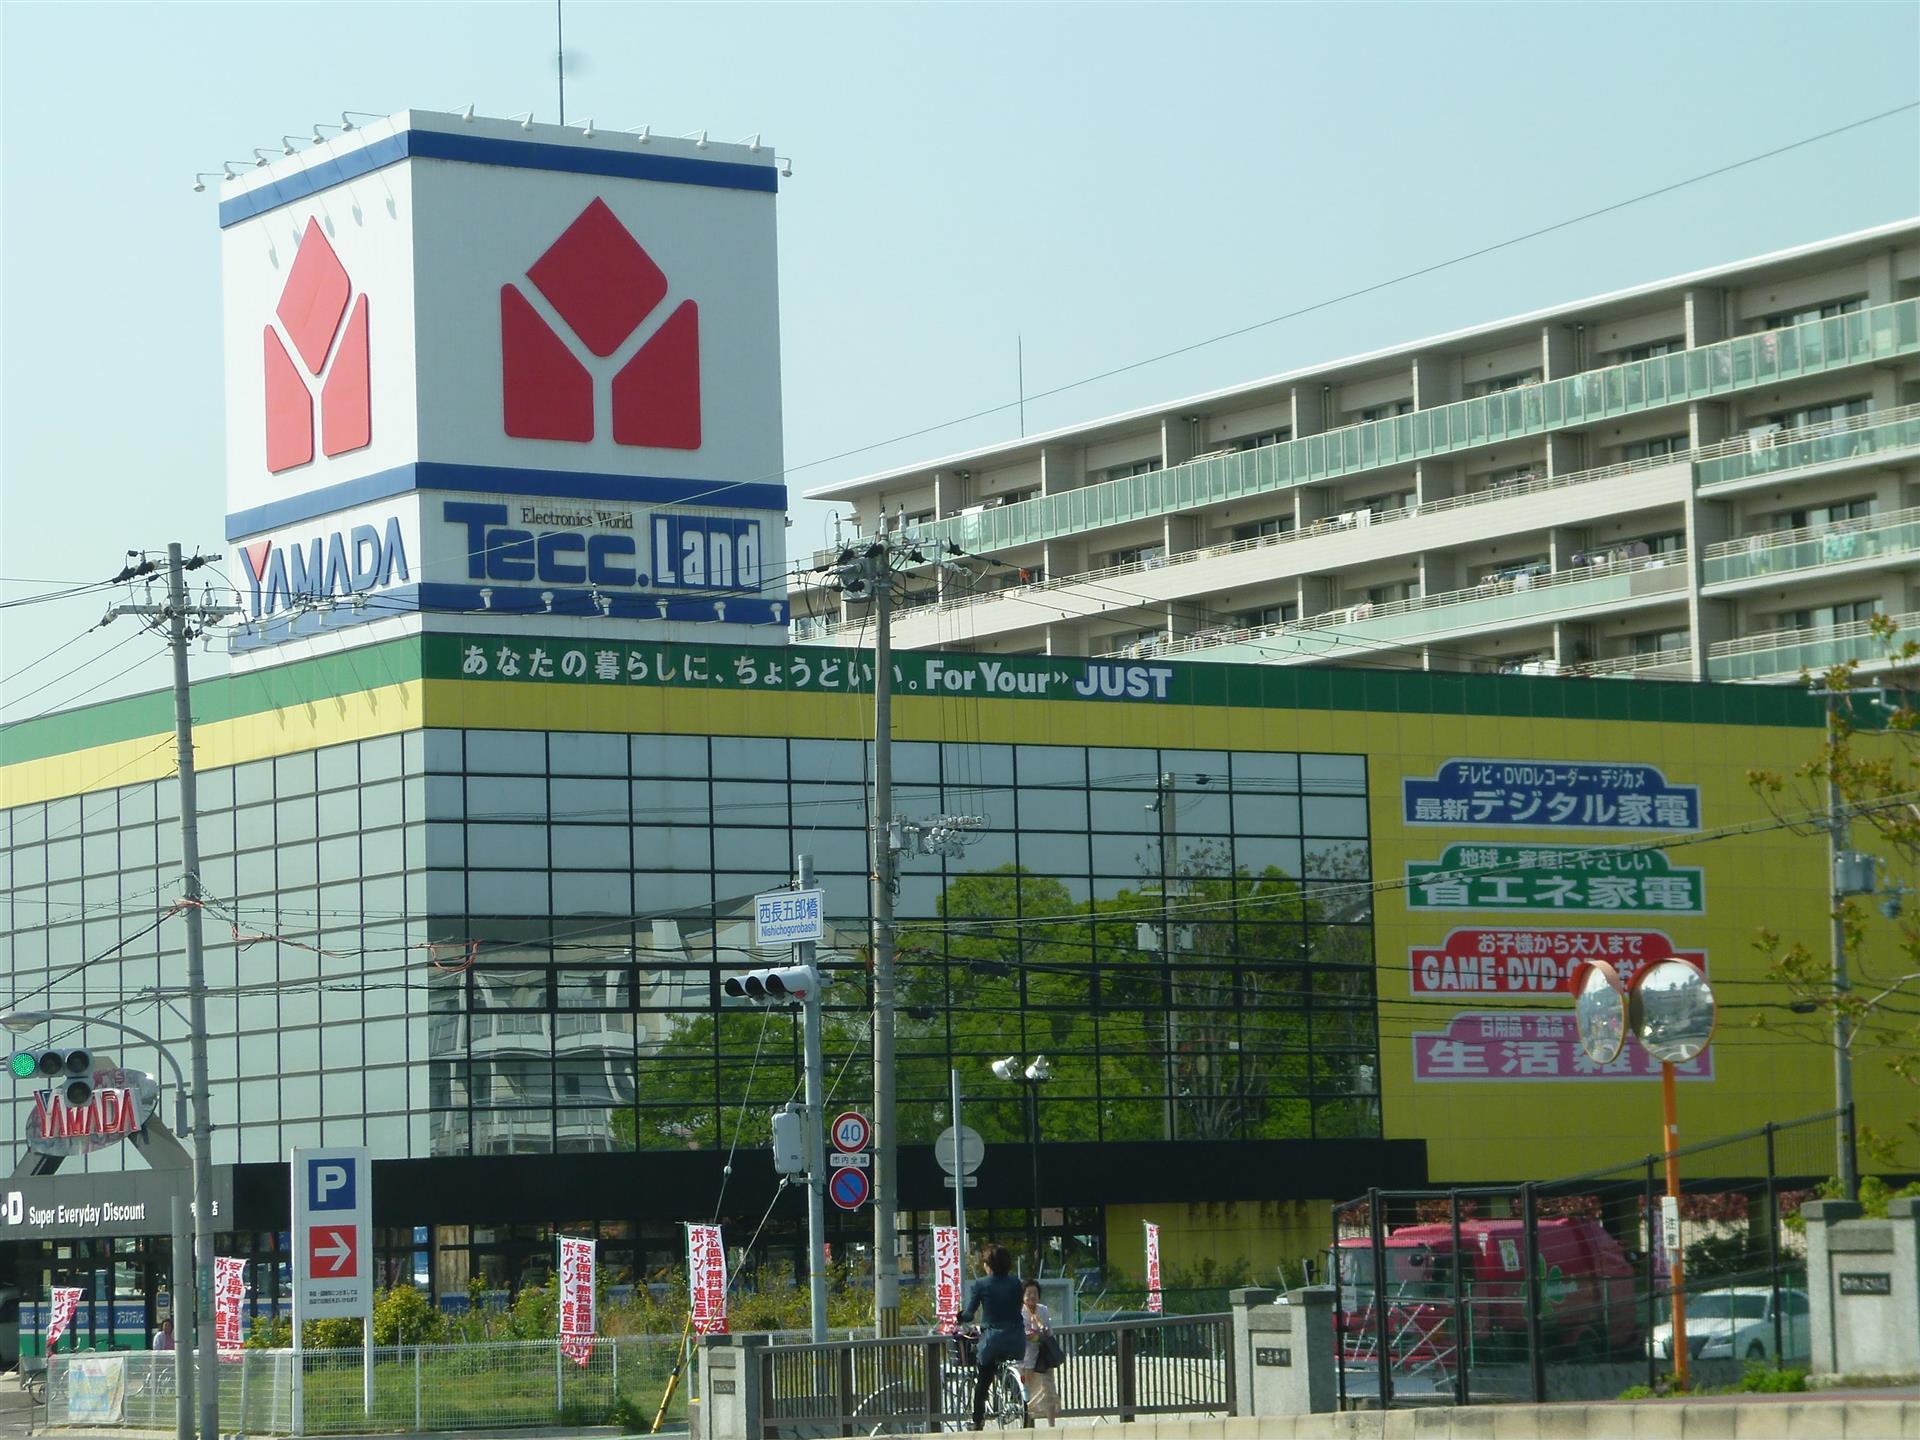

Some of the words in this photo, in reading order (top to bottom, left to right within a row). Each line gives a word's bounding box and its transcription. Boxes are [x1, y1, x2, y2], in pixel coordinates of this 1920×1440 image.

[520, 506, 593, 527] Electronics
[596, 511, 634, 529] World
[238, 516, 410, 618] YAMADA
[1075, 664, 1173, 698] JUST
[1415, 789, 1691, 827] 最新デジタル家電
[1417, 871, 1694, 910] 省エネ家電
[759, 897, 818, 924] 西長五郎橋
[1478, 932, 1643, 955] お子様から大人まで
[33, 1087, 139, 1138] YAMADA
[840, 1124, 861, 1142] 40
[317, 1166, 347, 1202] P
[29, 1206, 55, 1228] Super
[58, 1202, 102, 1227] Everyday
[103, 1202, 146, 1222] Discount
